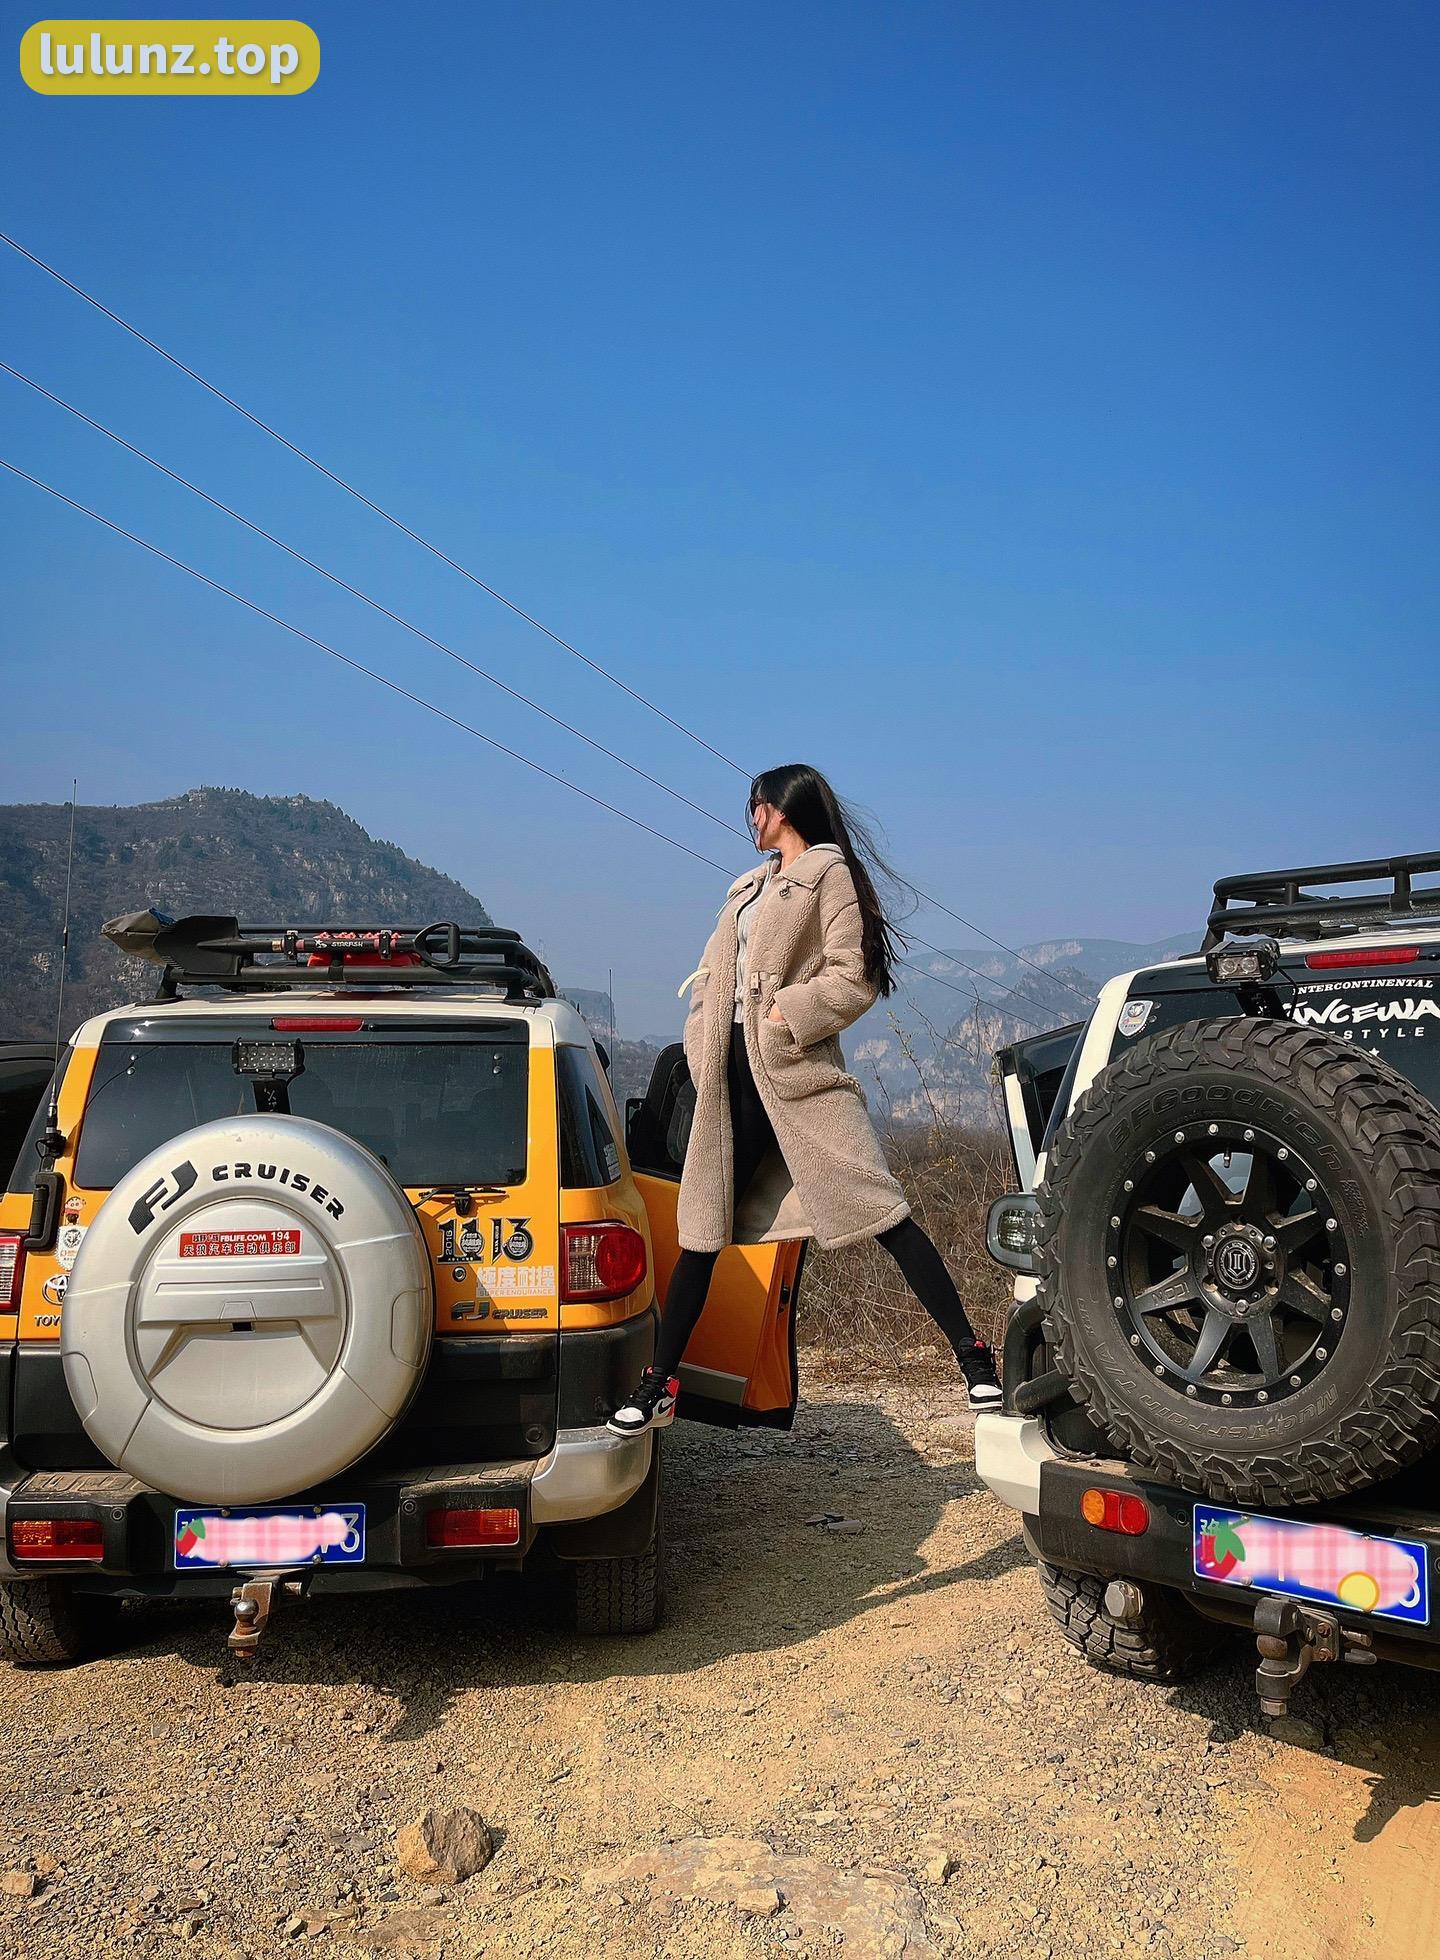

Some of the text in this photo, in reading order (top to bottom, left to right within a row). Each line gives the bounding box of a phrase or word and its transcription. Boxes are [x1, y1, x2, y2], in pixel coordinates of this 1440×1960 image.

[1292, 978, 1434, 996] INTERCONTINENTAL
[1328, 1026, 1425, 1042] STYLE
[1107, 1085, 1343, 1170] BFGoodrich
[128, 1160, 345, 1235] FJ CRUISER
[220, 1233, 267, 1243] FBLIFE.COM
[271, 1231, 290, 1241] 194
[34, 1314, 61, 1327] TOY
